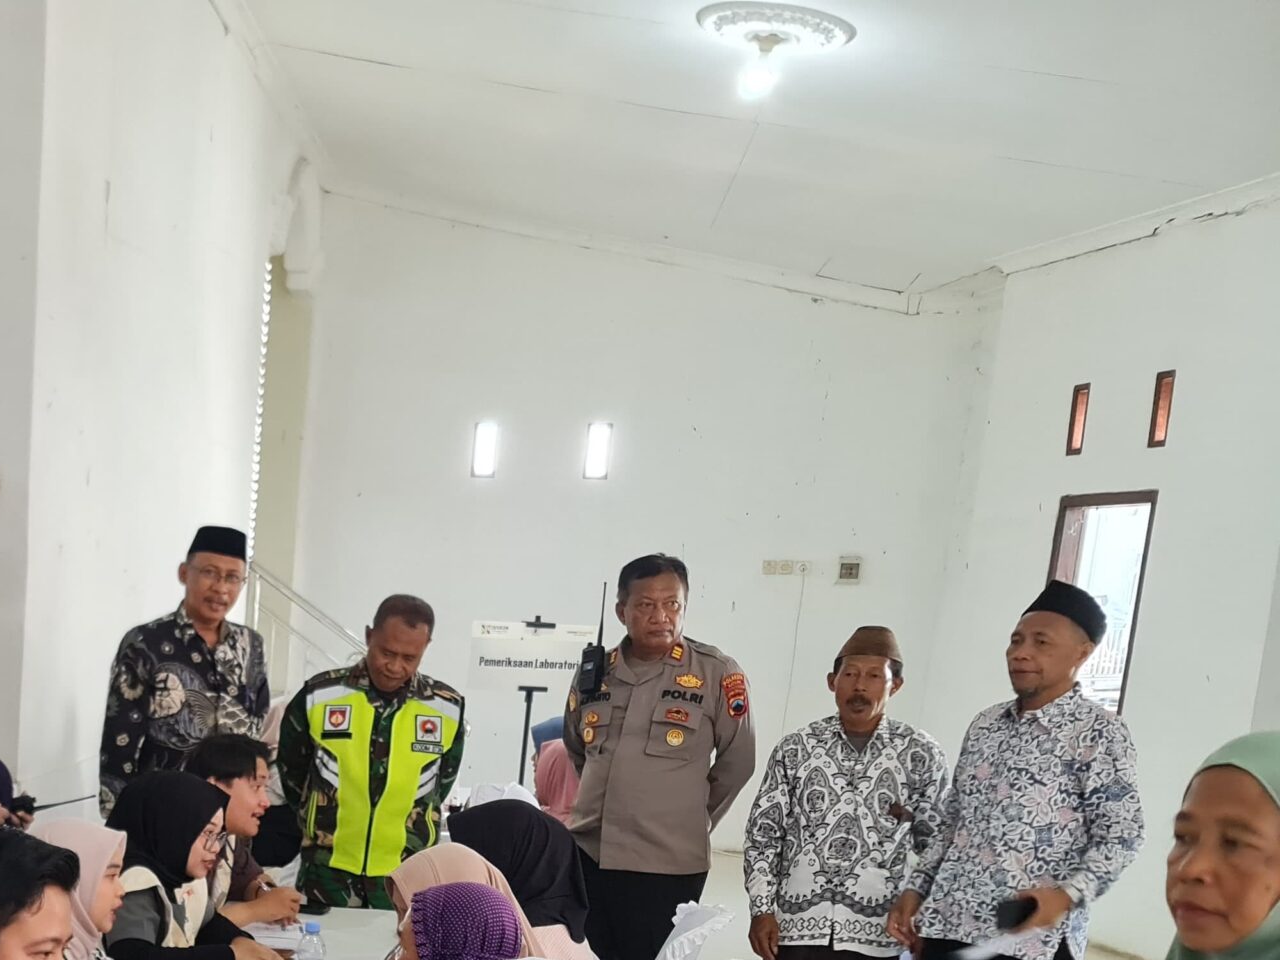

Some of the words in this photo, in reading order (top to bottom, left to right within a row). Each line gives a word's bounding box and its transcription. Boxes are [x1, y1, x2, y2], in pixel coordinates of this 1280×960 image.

[479, 657, 534, 669] Pemeriksaan
[535, 659, 579, 671] Laboratori
[662, 689, 704, 705] POLRI
